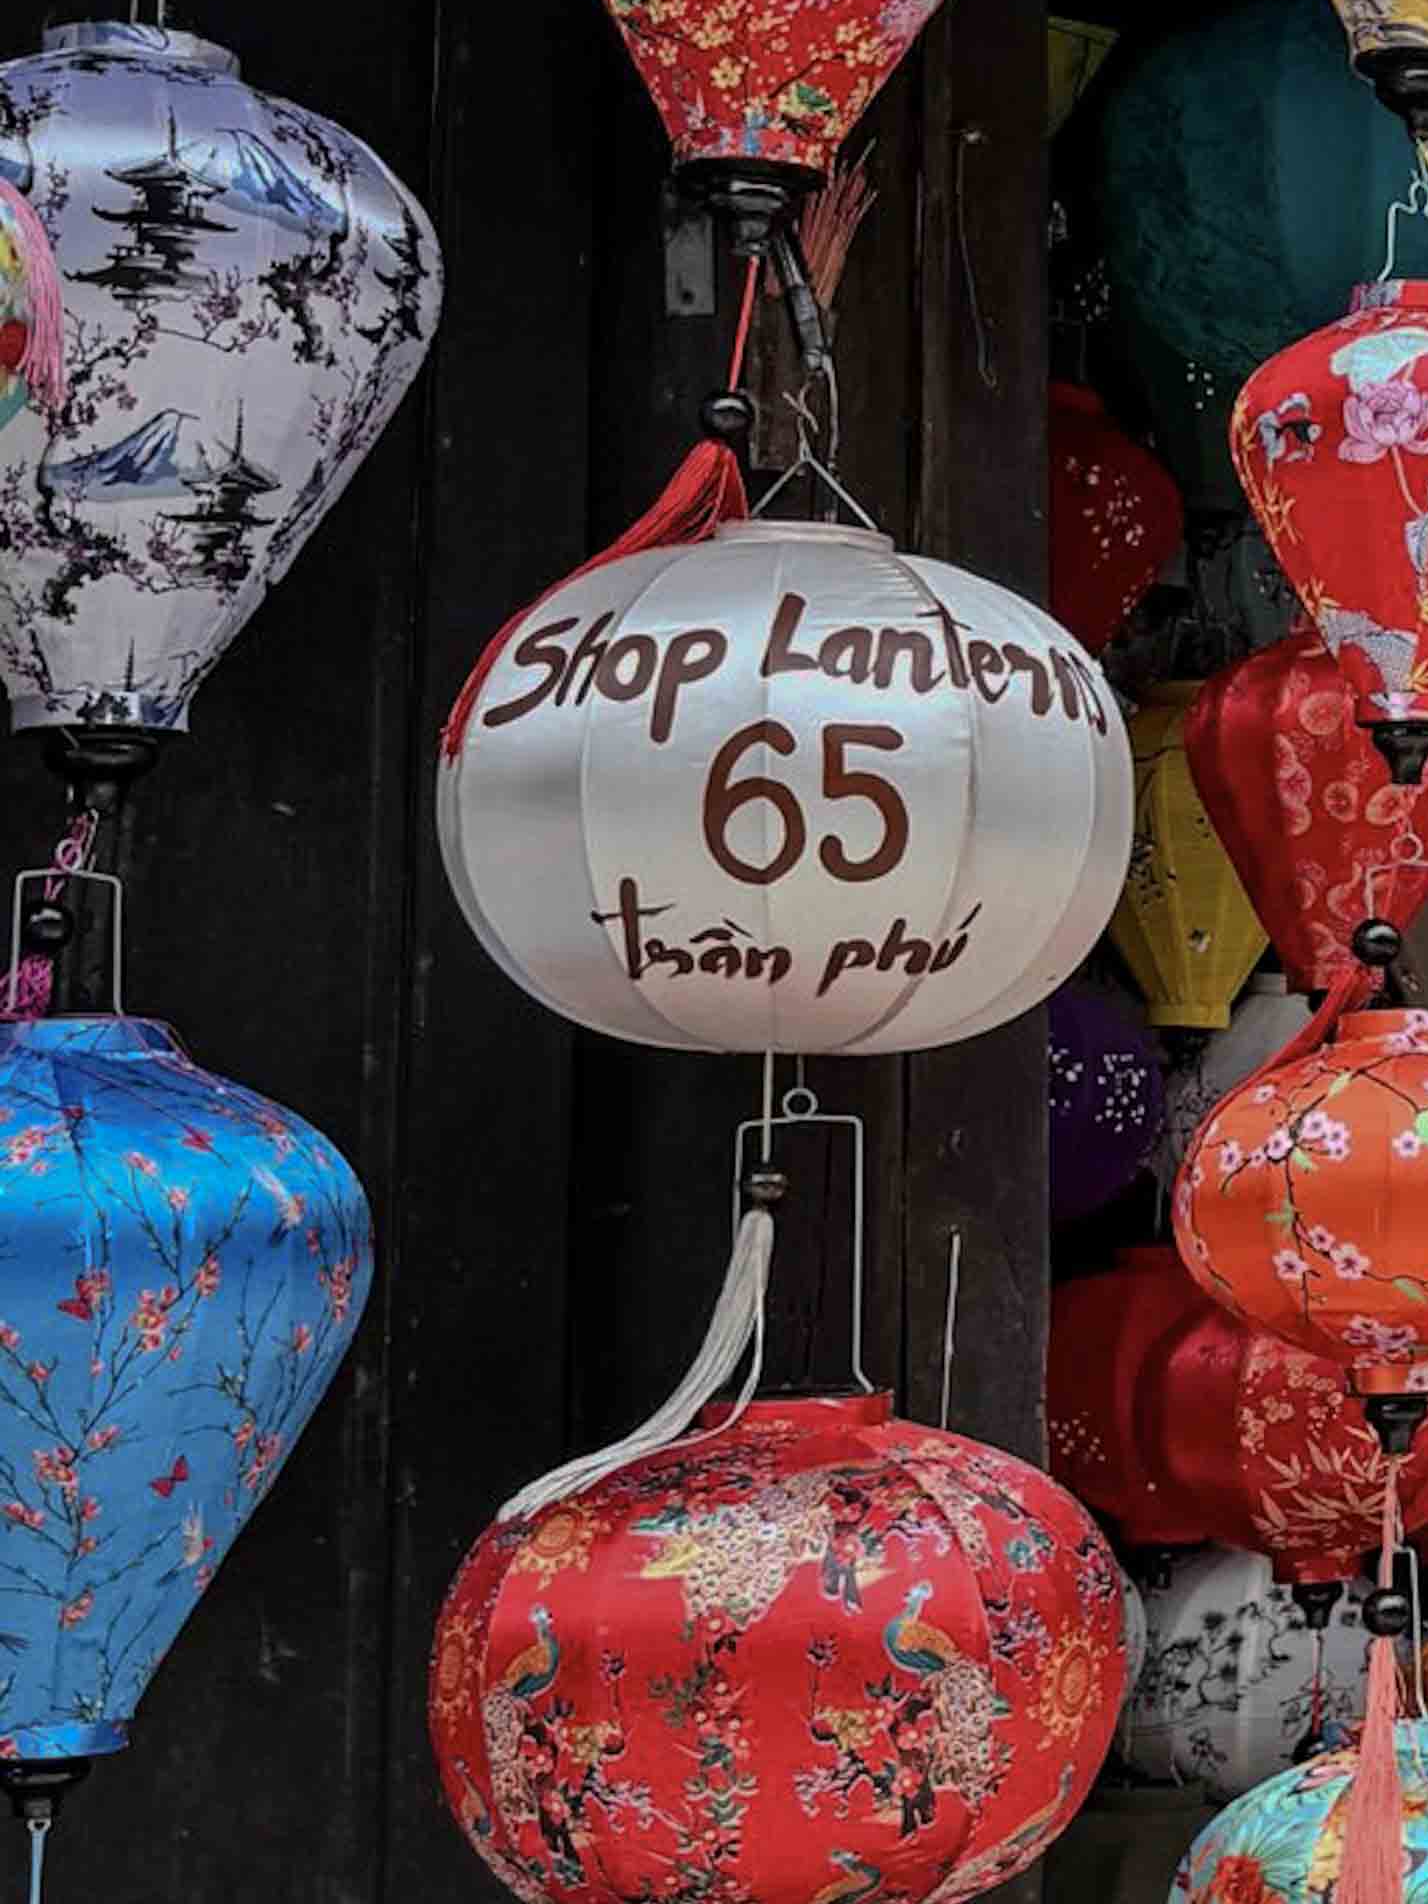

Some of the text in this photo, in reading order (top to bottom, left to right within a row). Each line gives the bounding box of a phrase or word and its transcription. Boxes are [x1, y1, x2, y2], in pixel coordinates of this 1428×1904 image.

[482, 591, 1110, 744] Shop Lanterns
[701, 718, 910, 887] 65
[815, 901, 984, 998] phú
